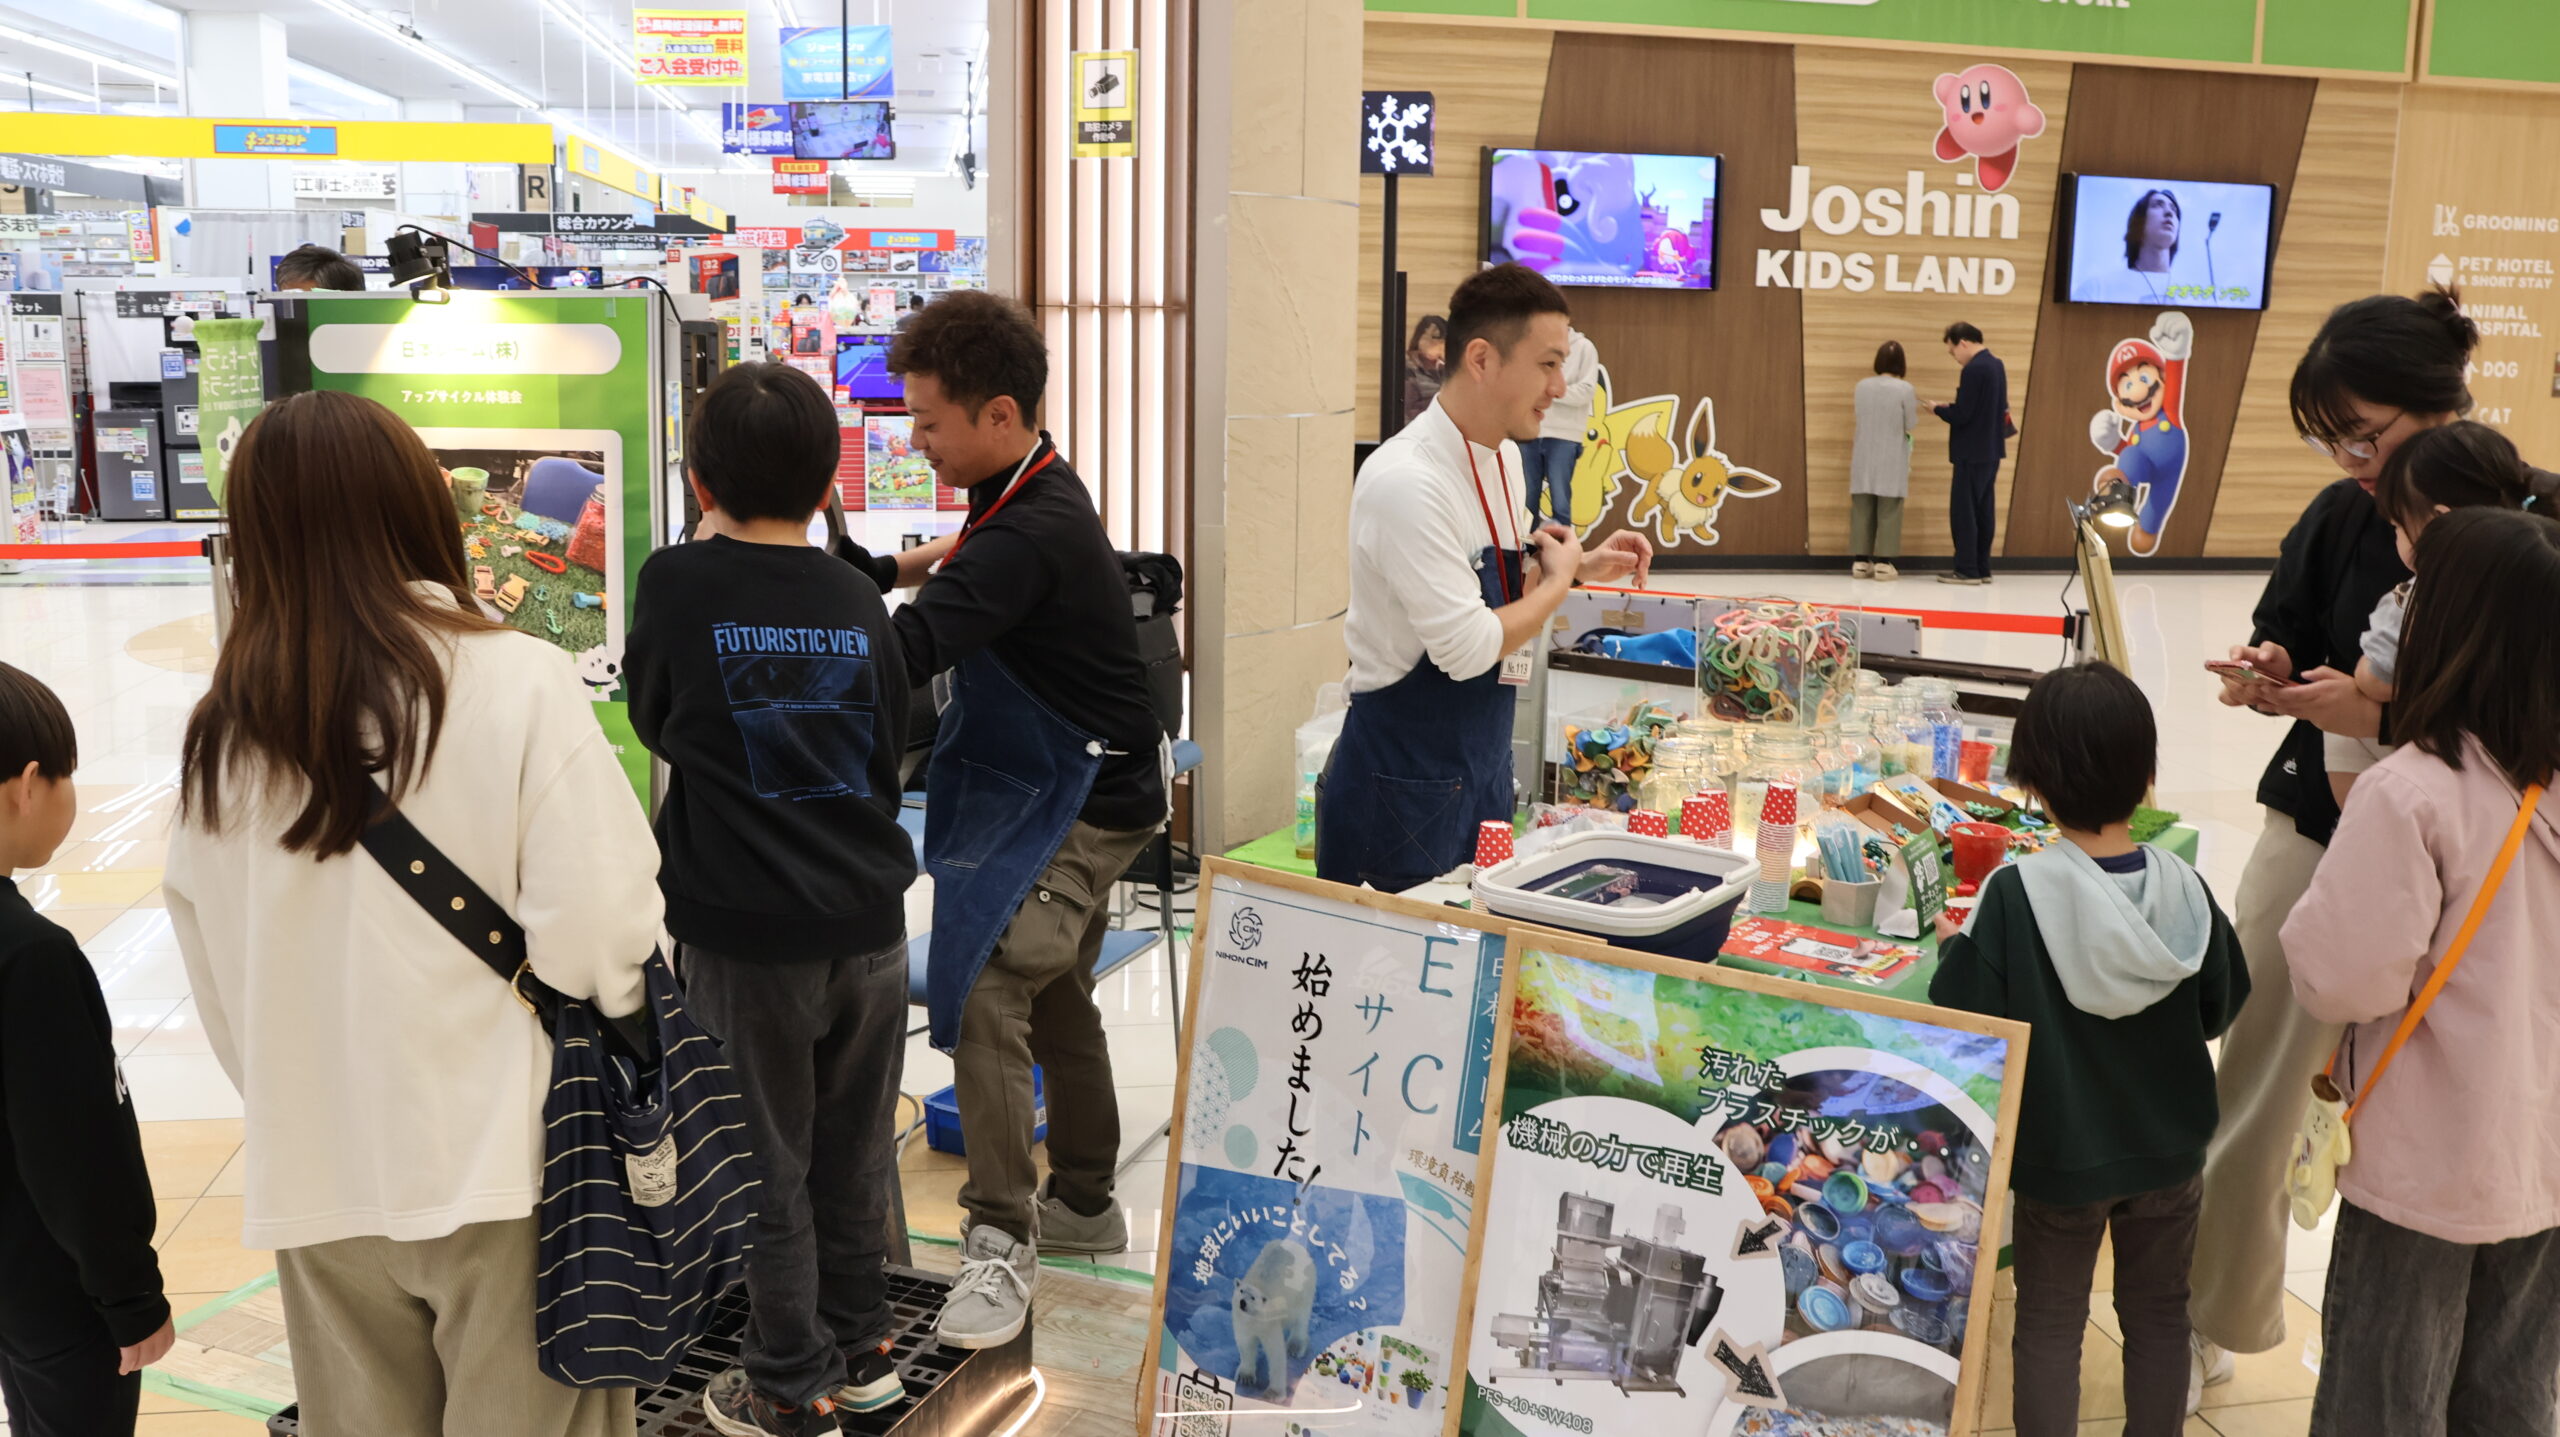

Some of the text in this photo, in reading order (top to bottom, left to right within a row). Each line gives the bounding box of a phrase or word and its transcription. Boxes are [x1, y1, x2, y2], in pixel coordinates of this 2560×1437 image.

[528, 176, 545, 198] R
[1760, 165, 2020, 239] Joshin
[557, 216, 638, 231] 総合カウンタ
[2463, 214, 2559, 233] GROOMING
[1756, 249, 2016, 295] KIDS LAND
[2459, 256, 2554, 274] PET HOTEL
[2471, 275, 2514, 288] SHORT
[2518, 277, 2553, 289] STAY
[12, 302, 43, 313] セット
[2461, 304, 2527, 320] ANIMAL
[2474, 321, 2542, 338] SPITAL
[2483, 361, 2518, 378] DOG
[401, 389, 523, 404] アップサイクル体験会
[2479, 407, 2512, 425] CAT
[714, 626, 869, 657] FUTURISTIC VIEW
[1215, 950, 1269, 971] NIHON CIM
[1348, 993, 1394, 1156] サイト
[1701, 1047, 1787, 1092] 汚れた
[1508, 1115, 1724, 1195] 機械の力で再生
[1192, 1205, 1367, 1311] 地球にいいことしてる?
[1477, 1384, 1593, 1435] PFS-40+SW408
